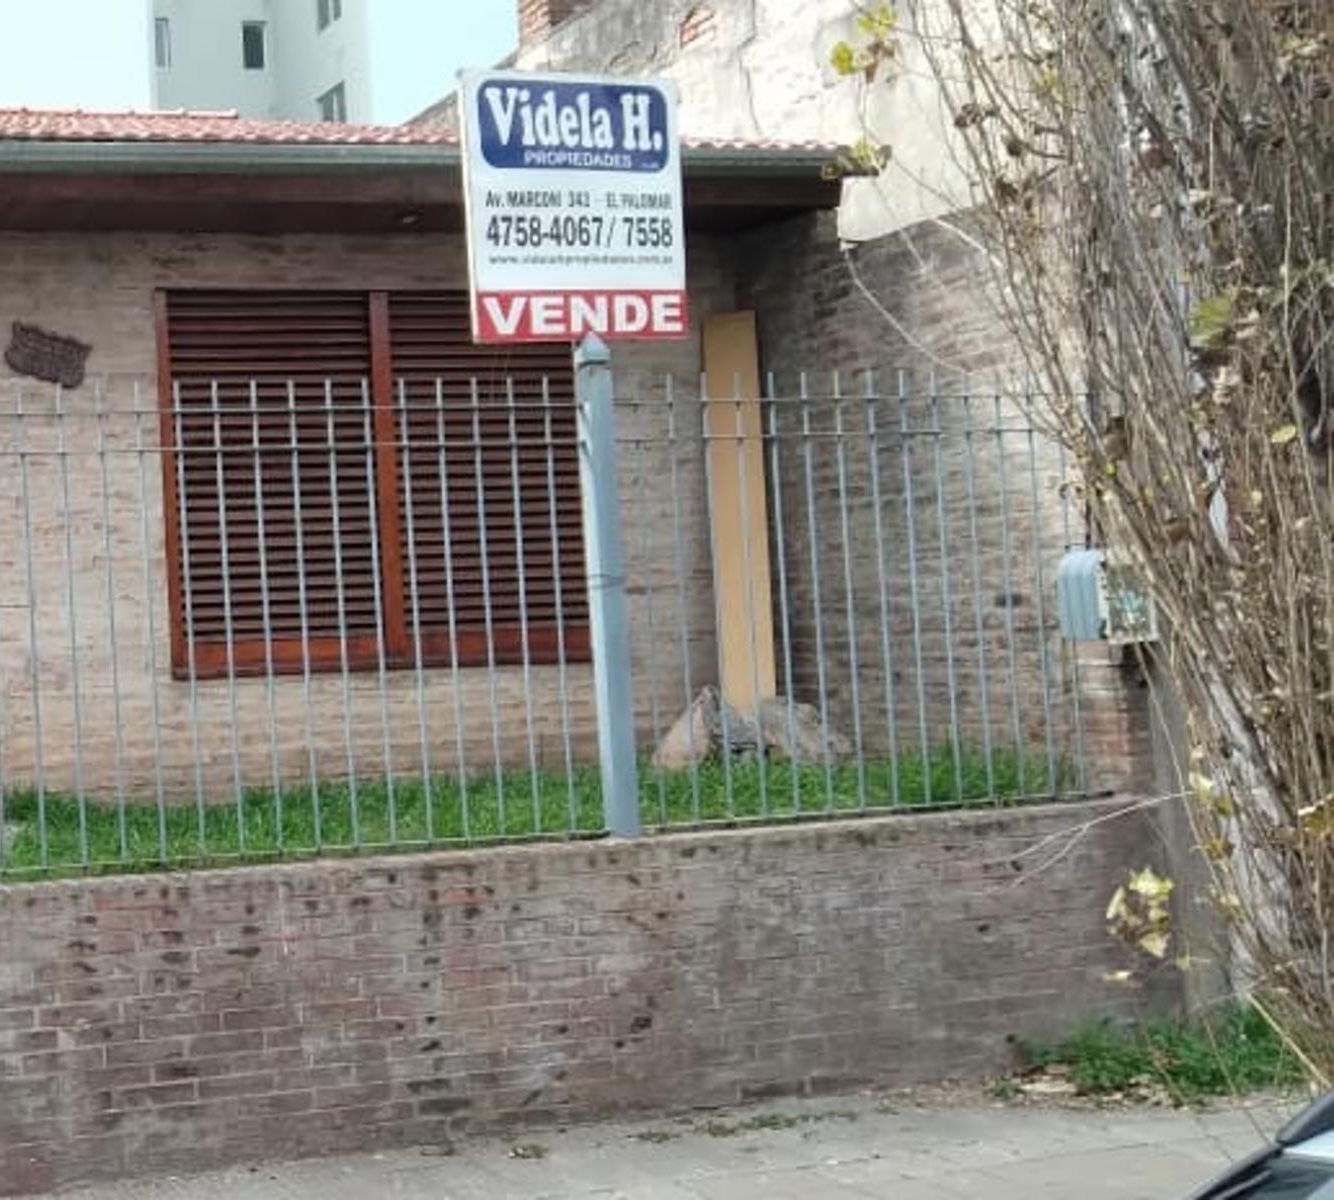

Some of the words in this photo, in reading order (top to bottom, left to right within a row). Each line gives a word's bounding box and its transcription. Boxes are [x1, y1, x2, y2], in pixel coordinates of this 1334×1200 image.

[484, 87, 614, 149] Videla
[620, 92, 663, 151] H.
[524, 151, 633, 169] PROPIEDADES
[485, 190, 505, 208] Av.
[506, 190, 562, 208] MARCONI
[623, 218, 674, 248] 7558
[482, 293, 684, 336] VENDE
